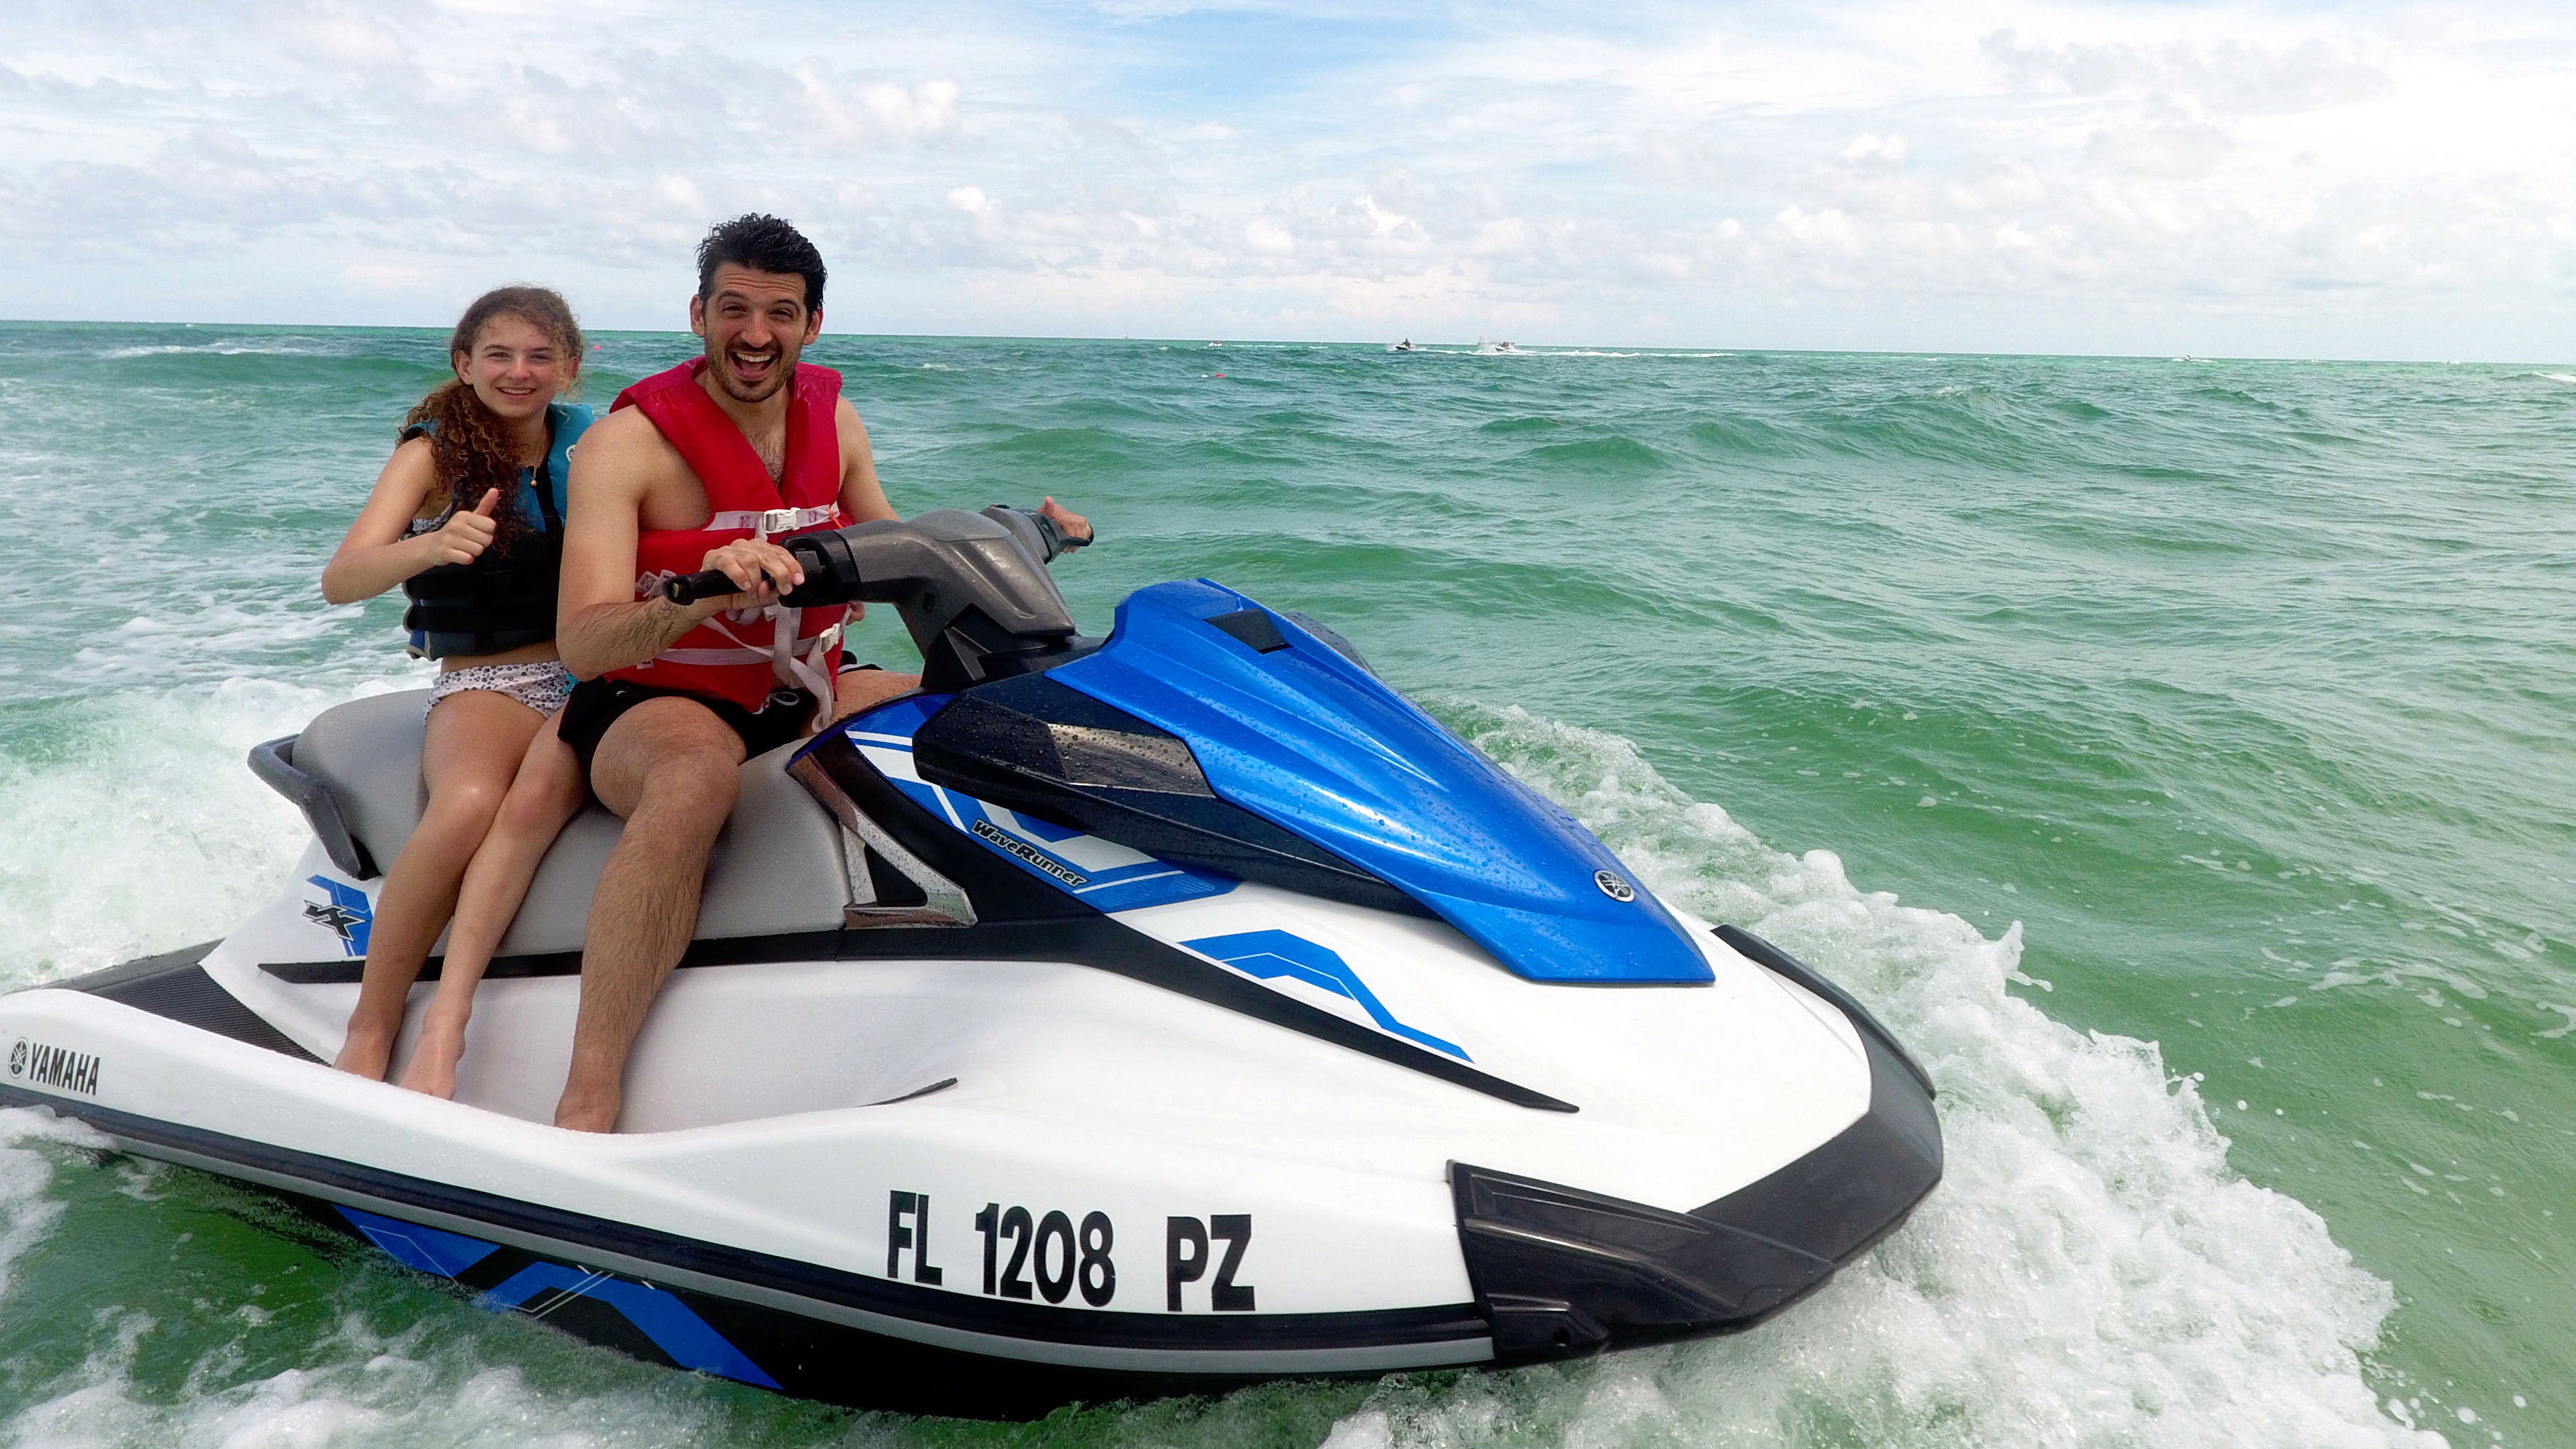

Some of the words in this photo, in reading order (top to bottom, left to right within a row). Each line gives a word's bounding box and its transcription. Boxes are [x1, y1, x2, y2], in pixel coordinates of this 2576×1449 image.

[972, 820, 1087, 887] WaveRunner
[29, 1043, 101, 1096] YAMAHA
[887, 1190, 942, 1286] FL
[975, 1202, 1116, 1307] 1208
[1167, 1214, 1256, 1311] PZ
